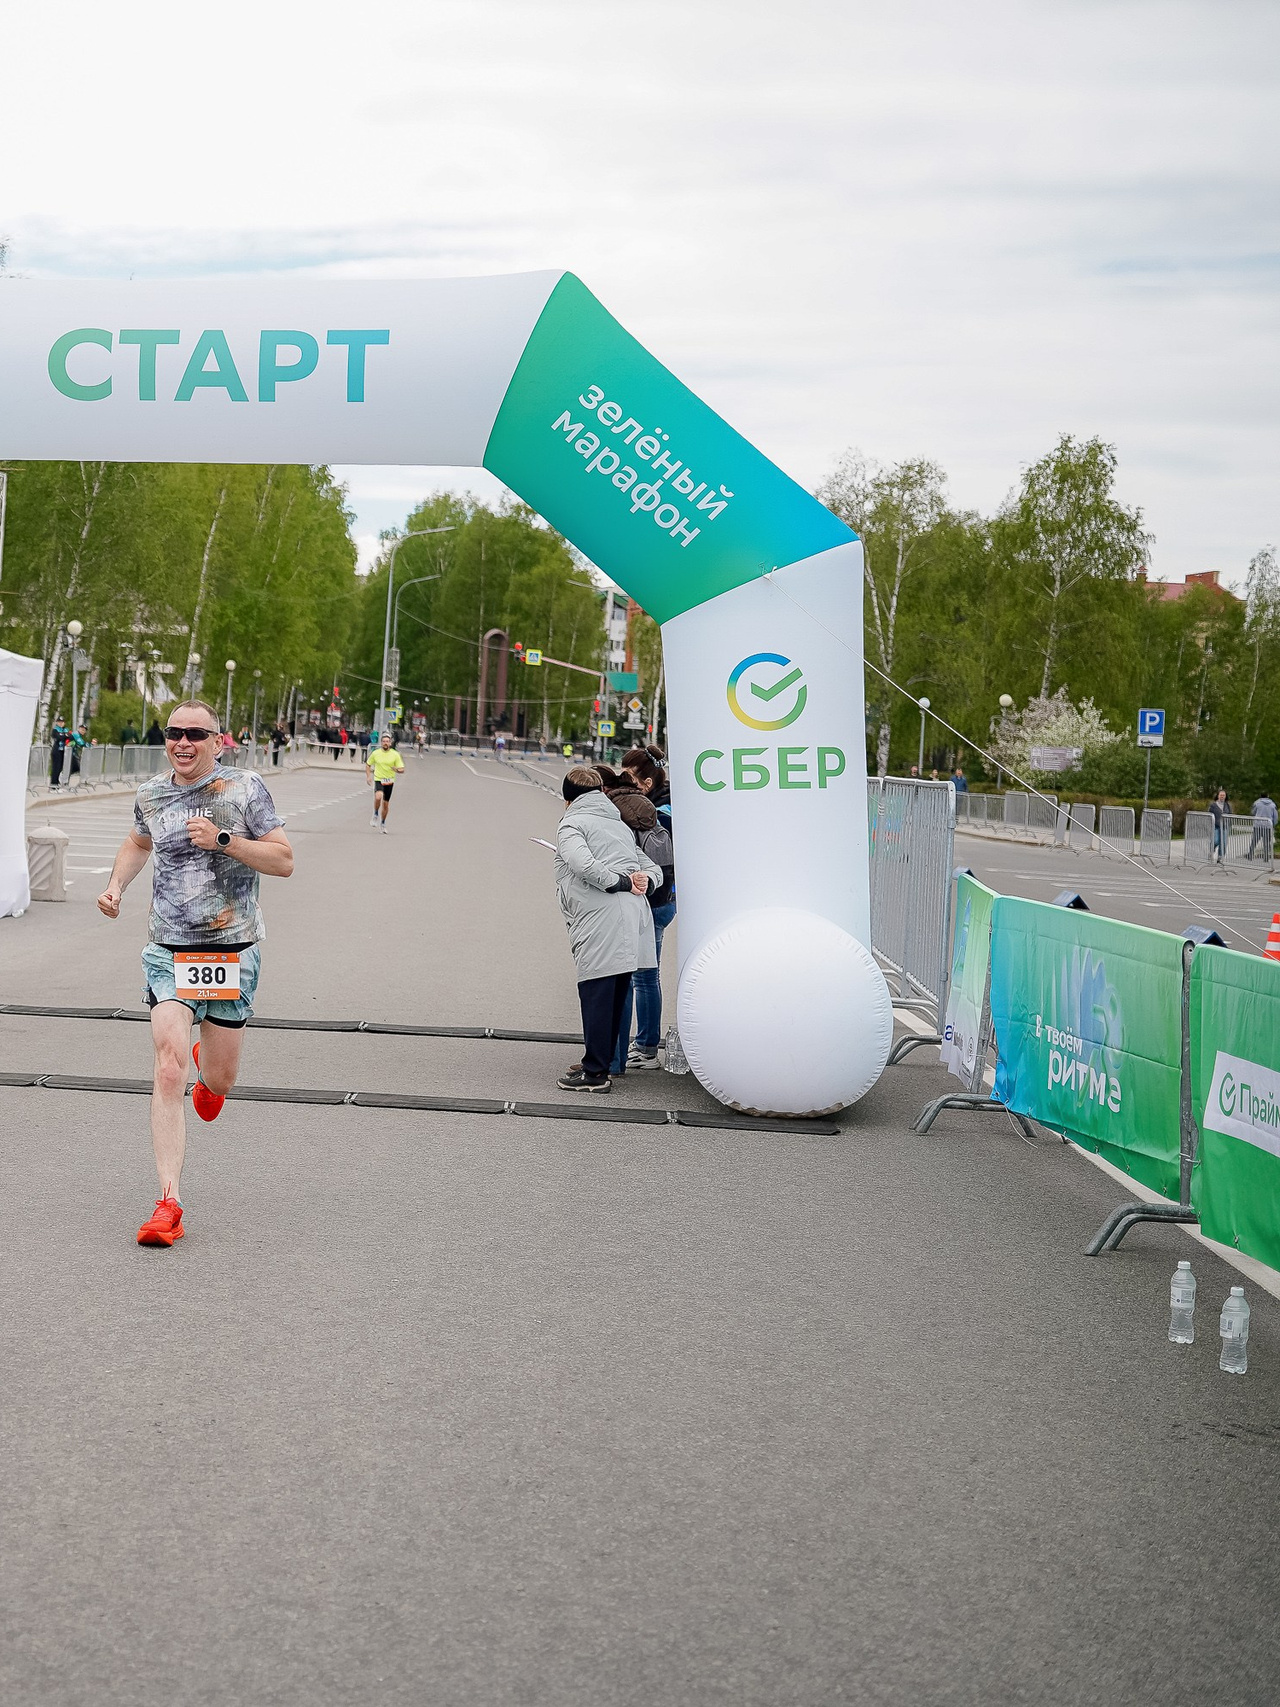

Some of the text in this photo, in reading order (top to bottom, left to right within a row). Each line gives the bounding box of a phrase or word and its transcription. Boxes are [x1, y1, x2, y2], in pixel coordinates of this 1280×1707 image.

[47, 327, 391, 403] СТАРТ
[550, 409, 702, 548] марафон
[578, 384, 735, 521] зелёный
[1145, 712, 1160, 732] P
[694, 746, 847, 792] СБЕР
[187, 966, 226, 985] 380
[1044, 1024, 1083, 1056] твоём
[1047, 1049, 1122, 1114] ритме
